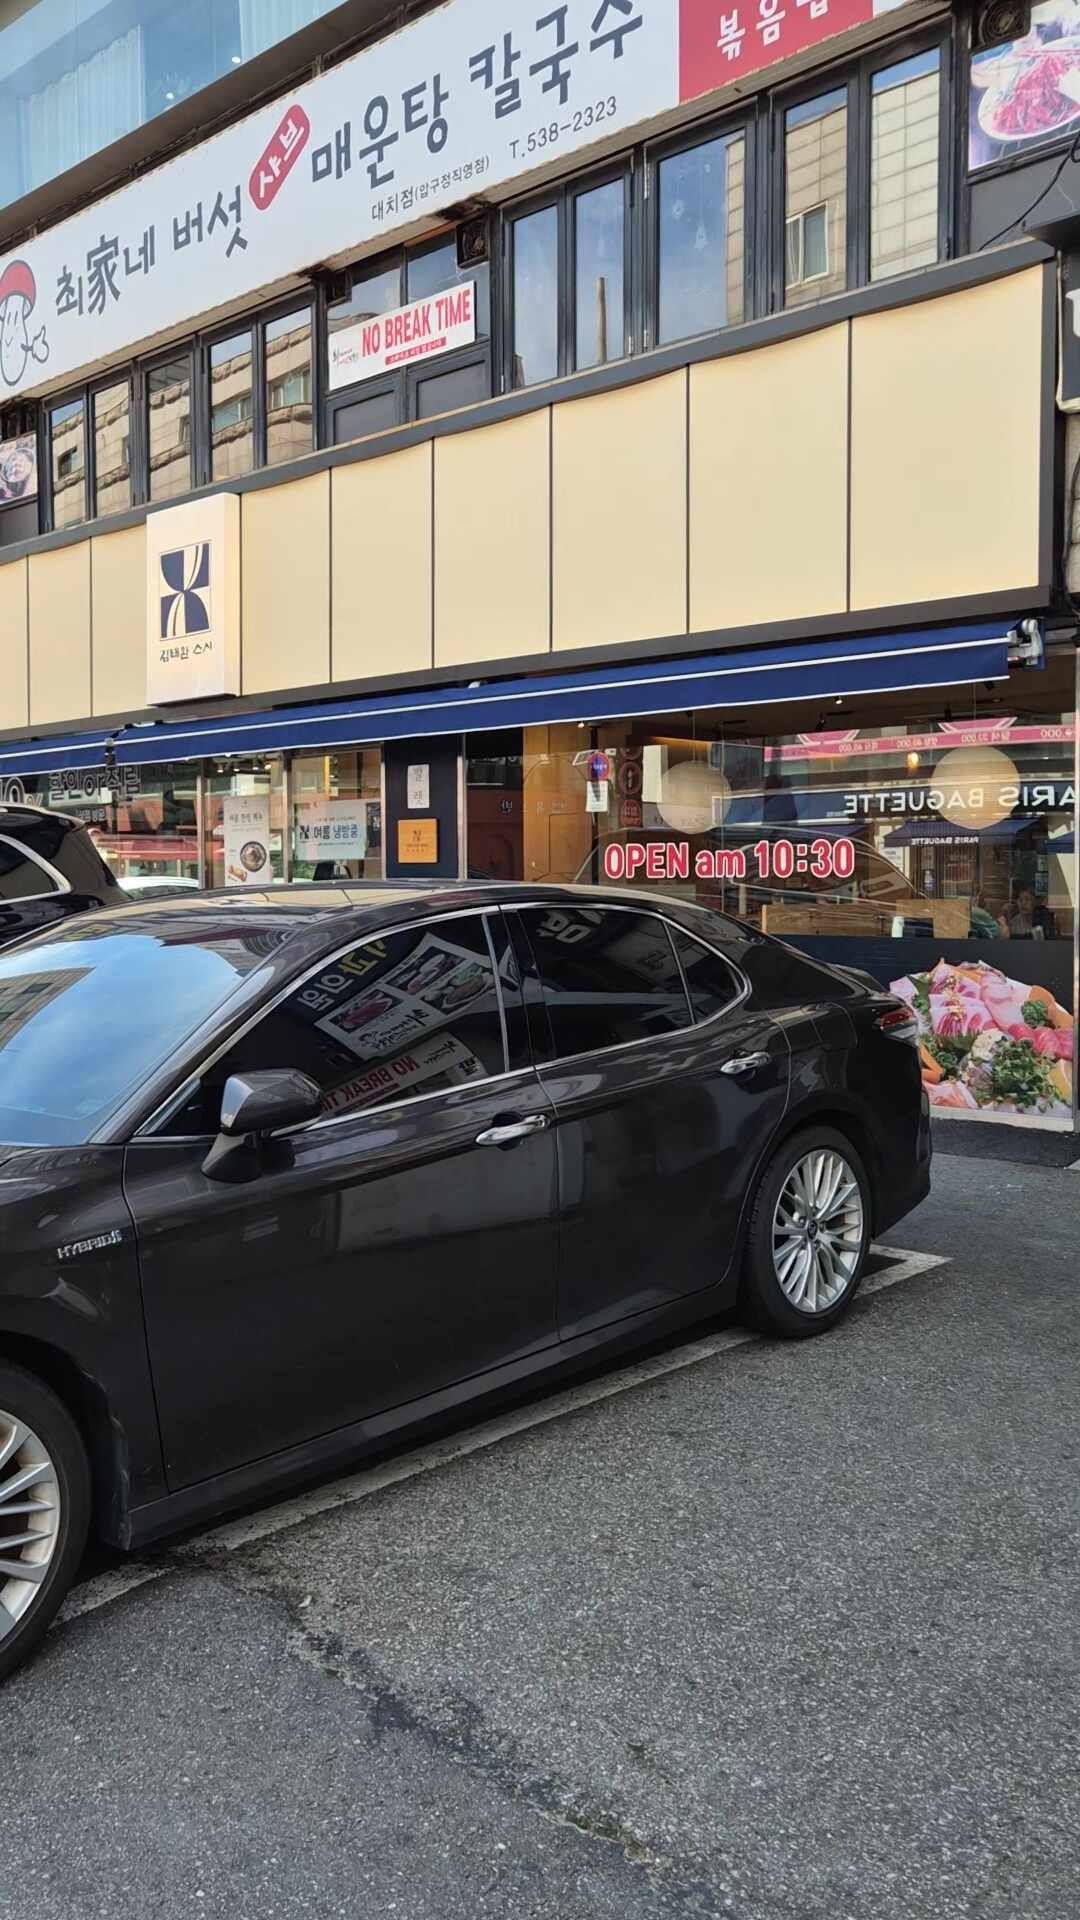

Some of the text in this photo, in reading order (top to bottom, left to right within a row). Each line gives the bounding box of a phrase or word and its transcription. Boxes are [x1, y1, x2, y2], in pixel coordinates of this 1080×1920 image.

[509, 99, 617, 160] T.538-2323
[55, 0, 643, 317] 최家네 버섯 매운탕 칼국수
[259, 118, 305, 199] 샤브
[362, 322, 380, 357] NO
[385, 304, 431, 349] BREAK
[435, 289, 471, 331] TIME
[192, 641, 213, 656] 스시
[313, 823, 358, 840] 여름 냉방중
[604, 837, 856, 880] OPEN am 10:30
[57, 1231, 114, 1260] HYBRID
